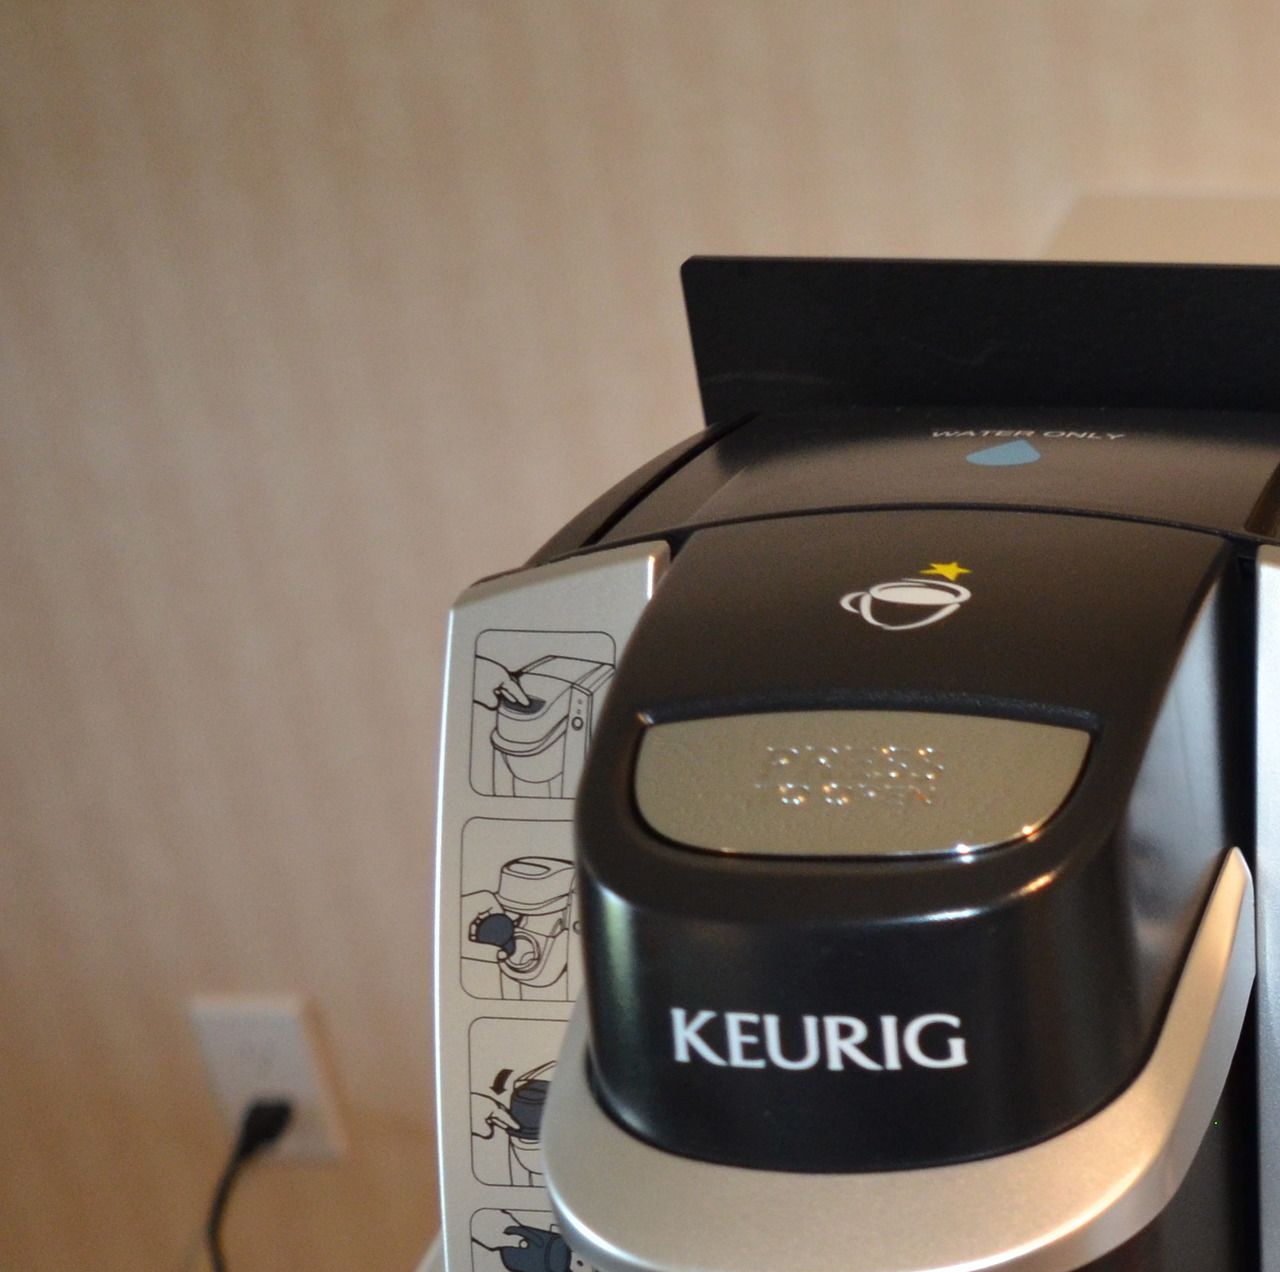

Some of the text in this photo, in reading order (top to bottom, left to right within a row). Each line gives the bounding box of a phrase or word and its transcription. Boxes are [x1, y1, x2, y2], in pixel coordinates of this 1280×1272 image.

[932, 430, 1126, 440] WATER ONLY
[670, 1007, 968, 1071] KEURIG
